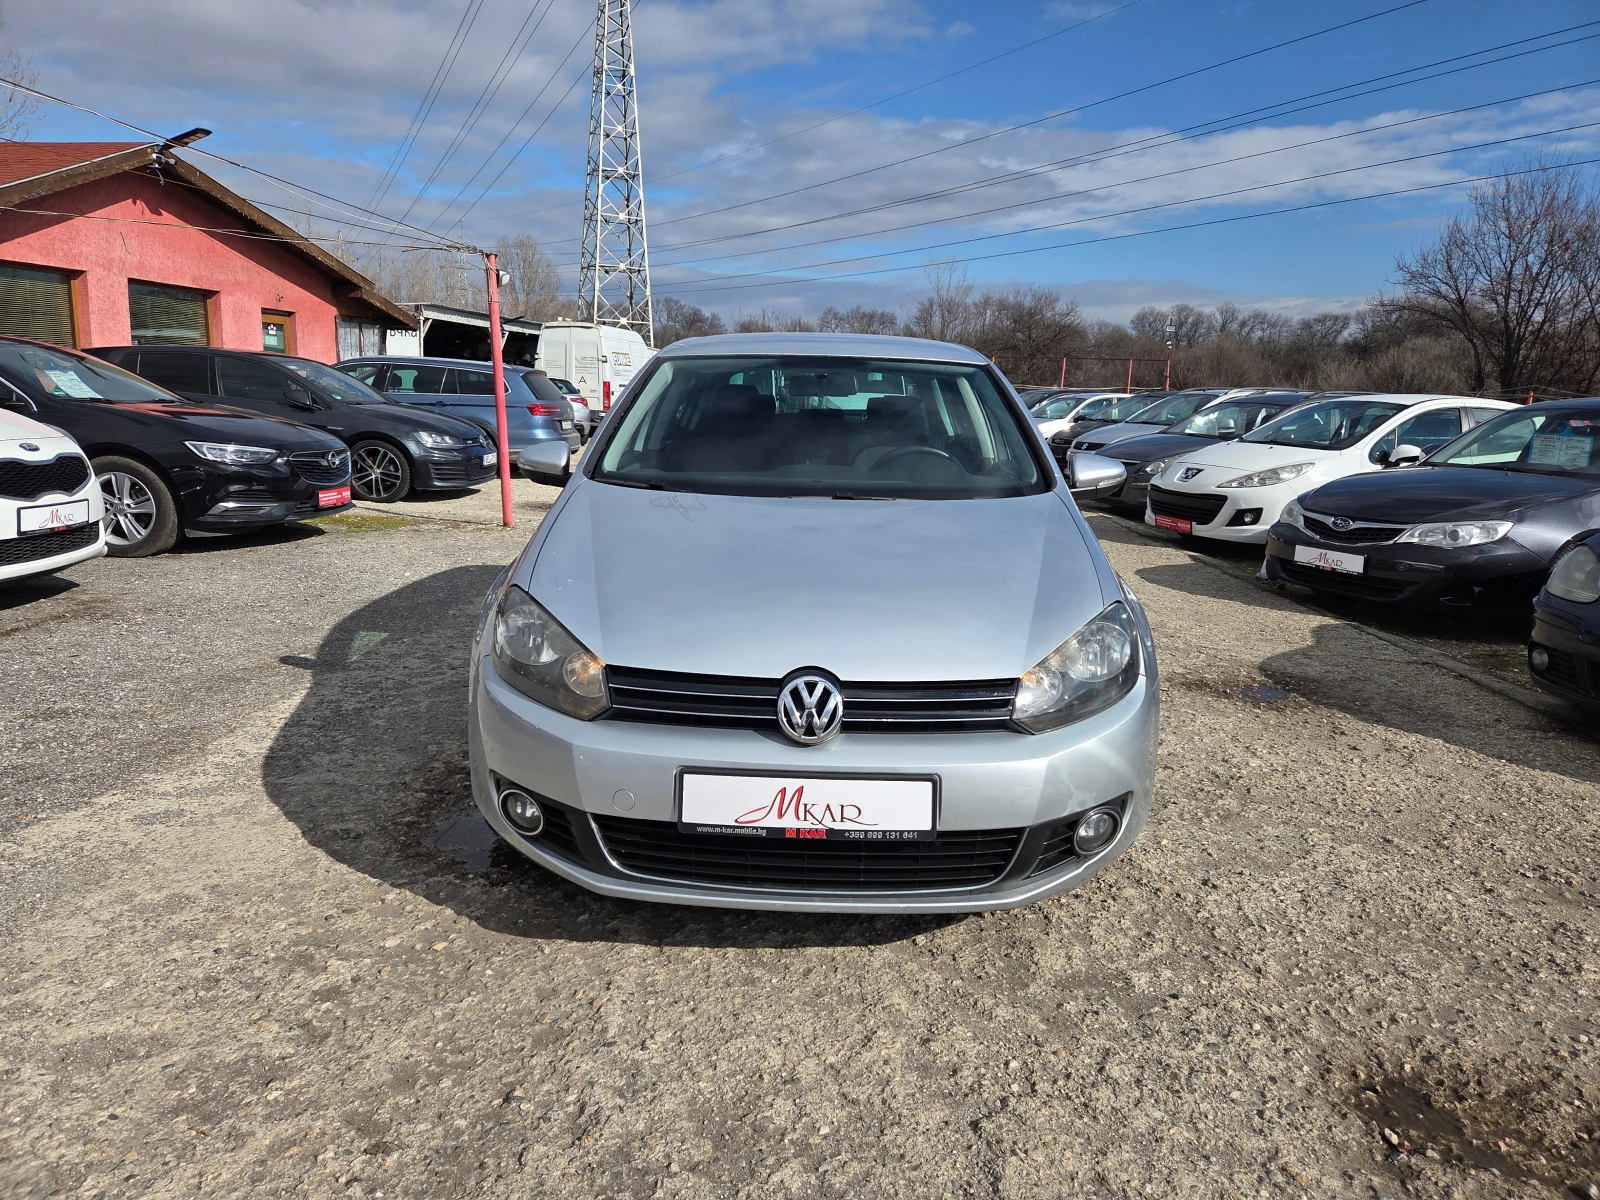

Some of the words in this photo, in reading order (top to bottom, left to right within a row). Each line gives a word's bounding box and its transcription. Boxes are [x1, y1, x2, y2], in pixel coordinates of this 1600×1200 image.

[578, 376, 587, 384] A
[734, 785, 879, 829] MKAR
[785, 828, 797, 838] M
[799, 828, 827, 839] KAR
[844, 831, 865, 839] +359
[885, 831, 900, 839] 131
